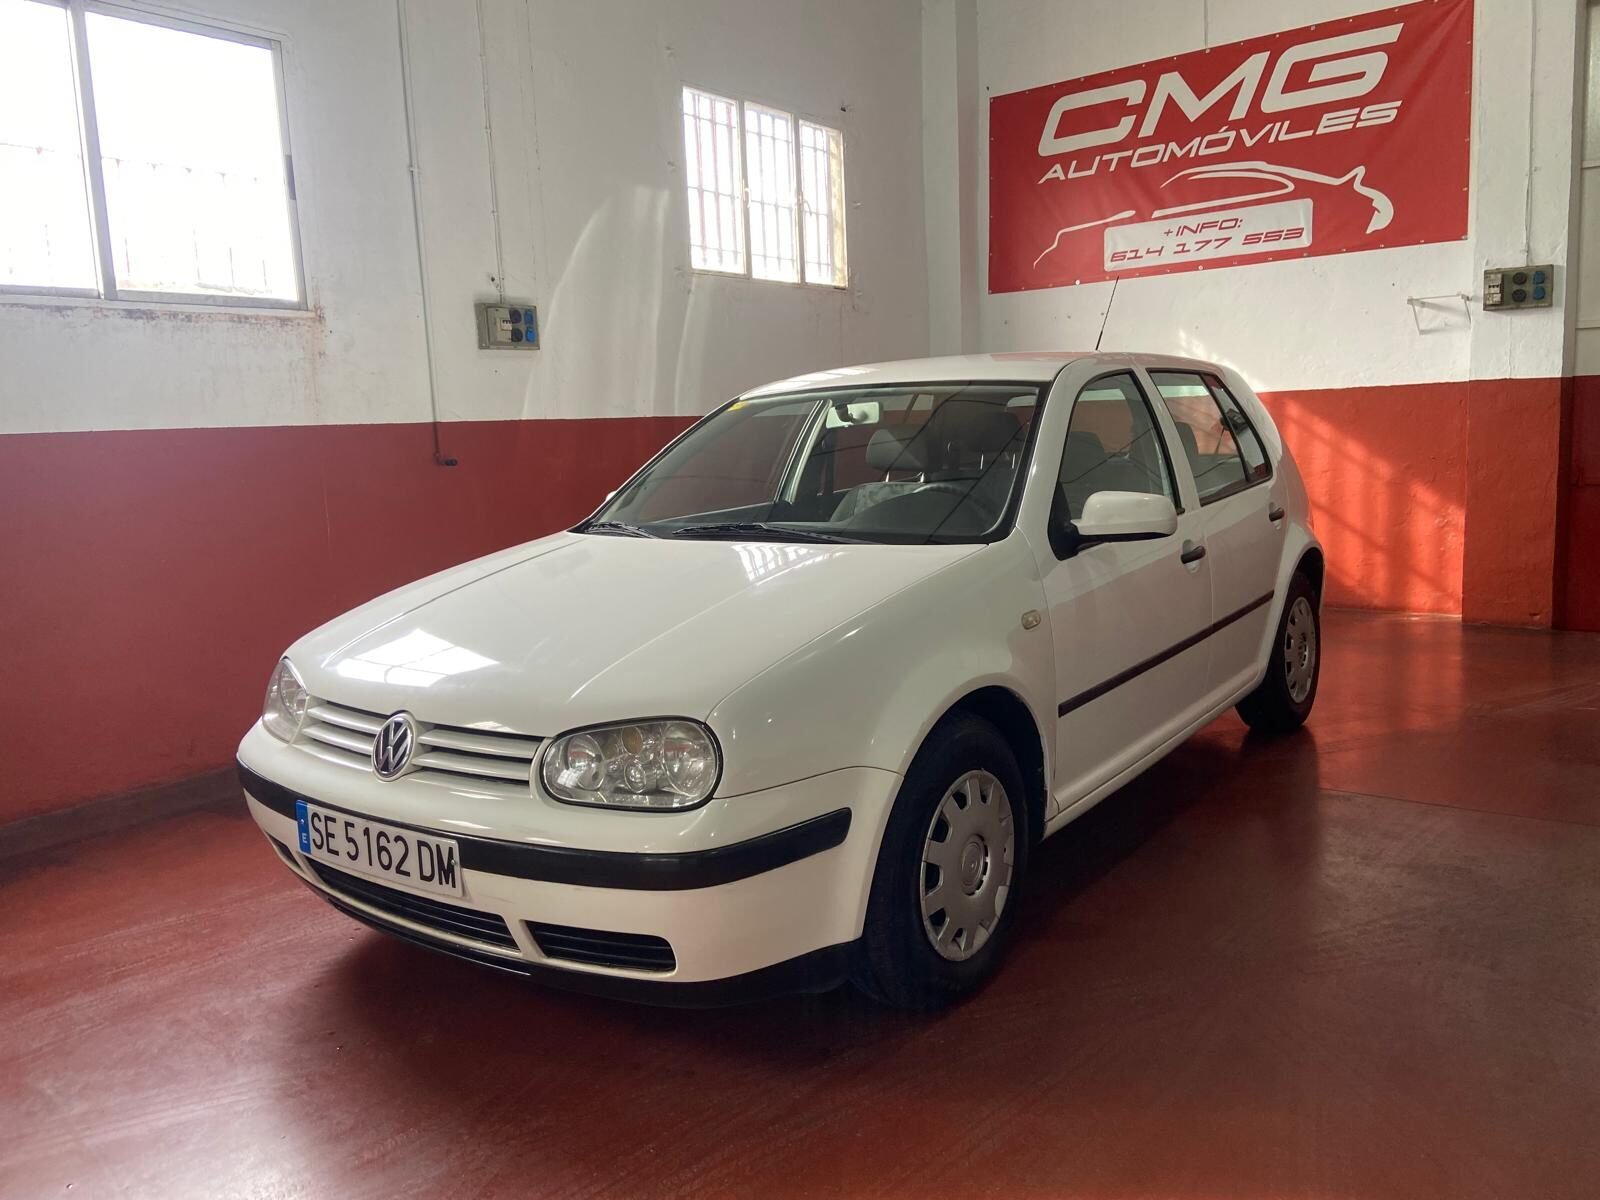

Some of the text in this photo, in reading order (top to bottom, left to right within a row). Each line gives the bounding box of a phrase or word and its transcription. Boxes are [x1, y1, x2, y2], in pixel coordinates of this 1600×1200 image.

[1038, 23, 1404, 156] CMG
[1038, 100, 1402, 184] AUTOMÓVILES
[1110, 246, 1164, 262] 614
[1173, 236, 1233, 255] 177
[302, 833, 307, 843] E
[310, 811, 456, 888] SE 5162 DM
